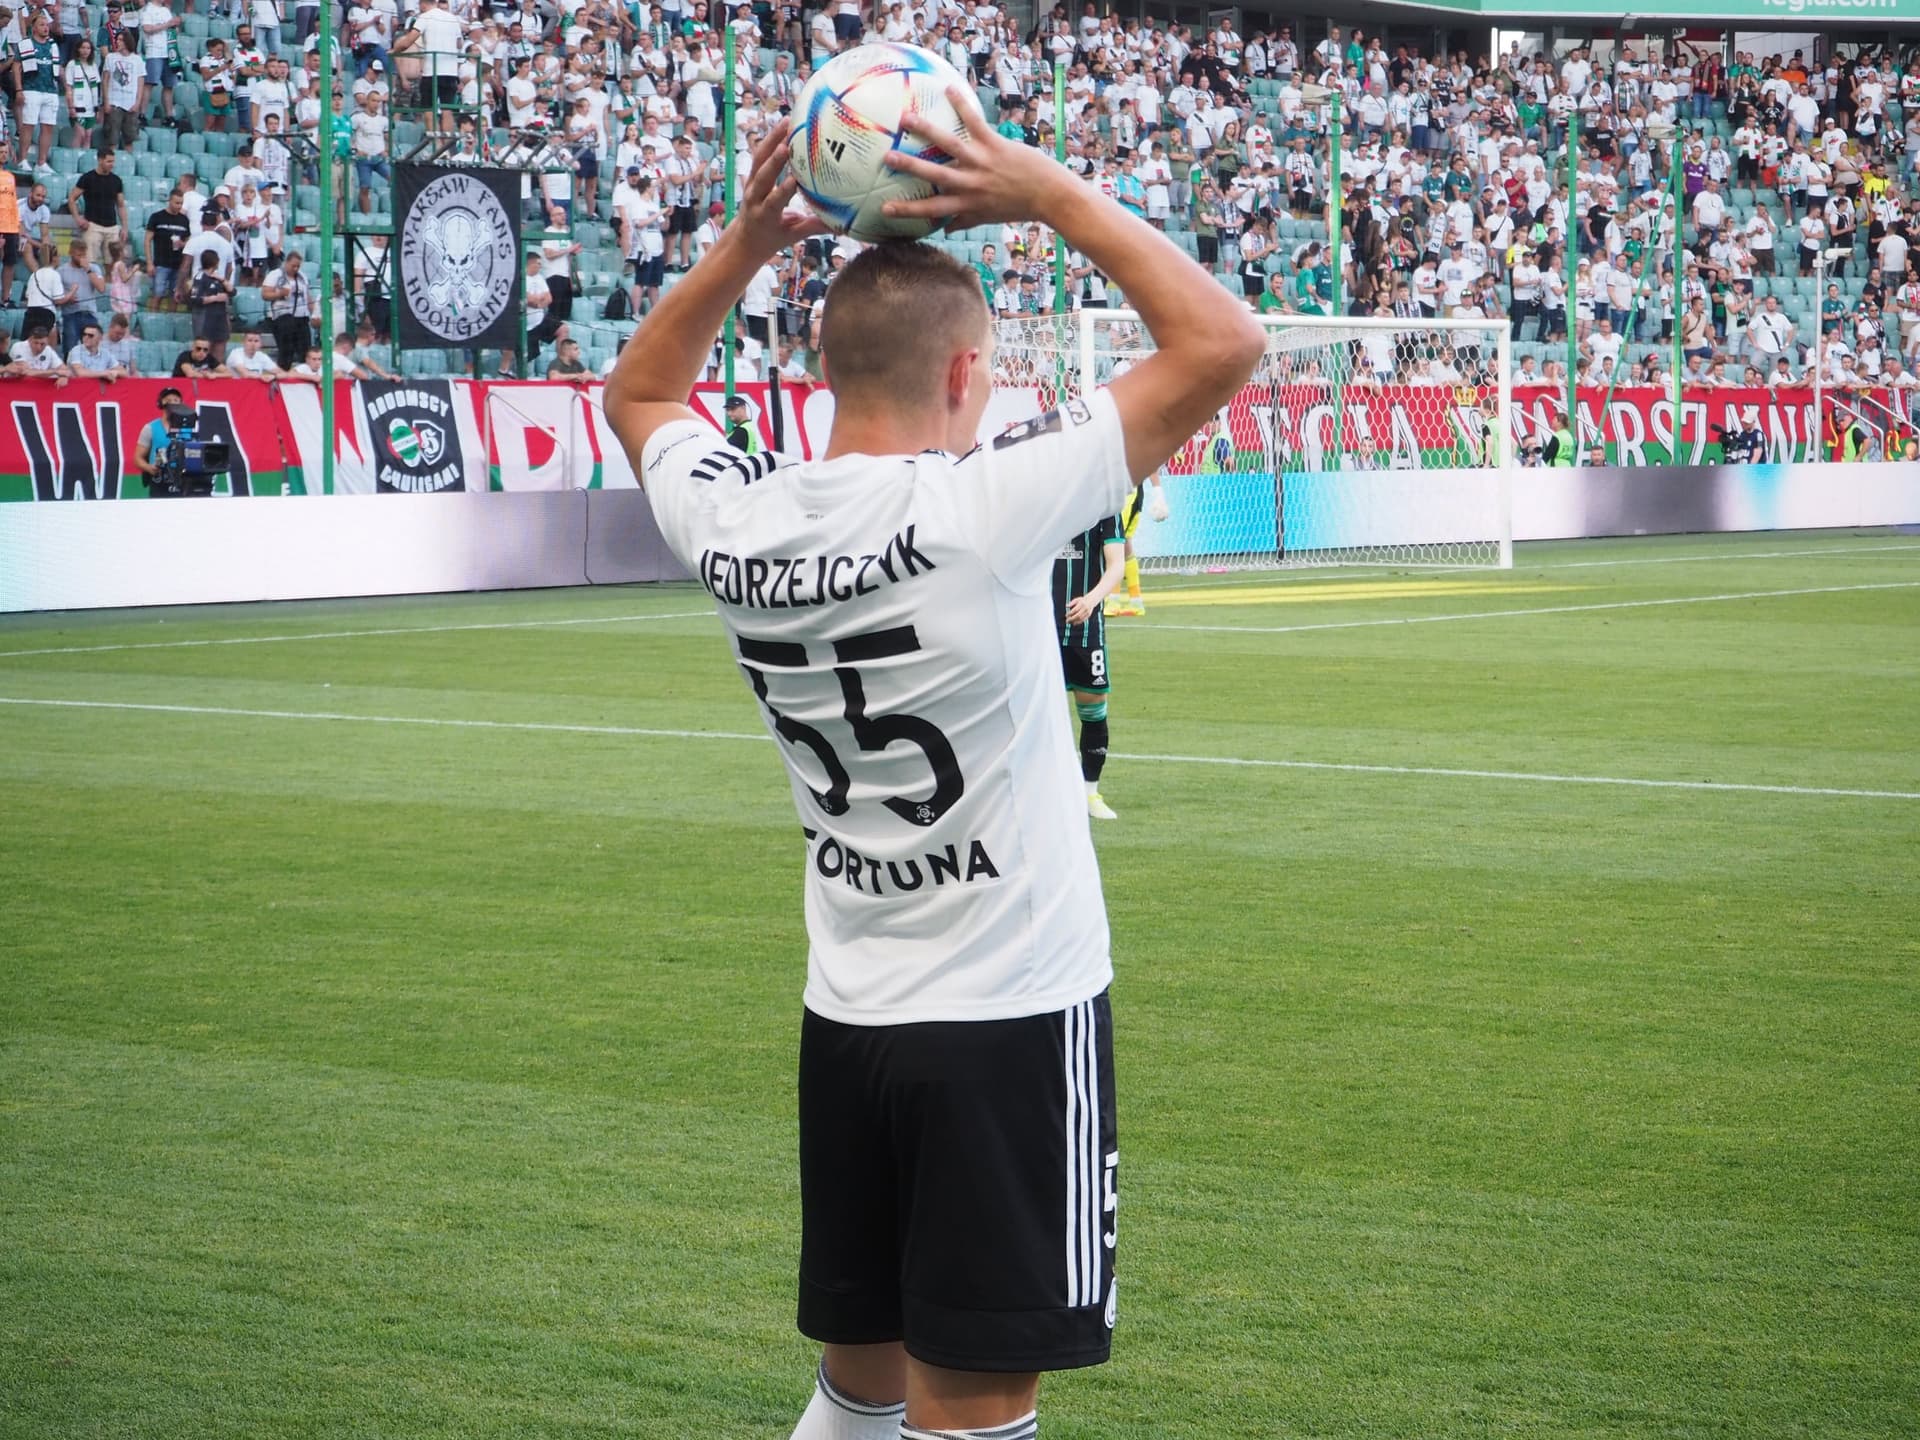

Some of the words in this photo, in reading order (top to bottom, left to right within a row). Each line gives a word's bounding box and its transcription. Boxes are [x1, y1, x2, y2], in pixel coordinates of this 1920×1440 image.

[404, 177, 469, 256] WARSAW
[478, 190, 512, 260] FANS
[1091, 650, 1105, 677] 8
[736, 624, 965, 827] 55
